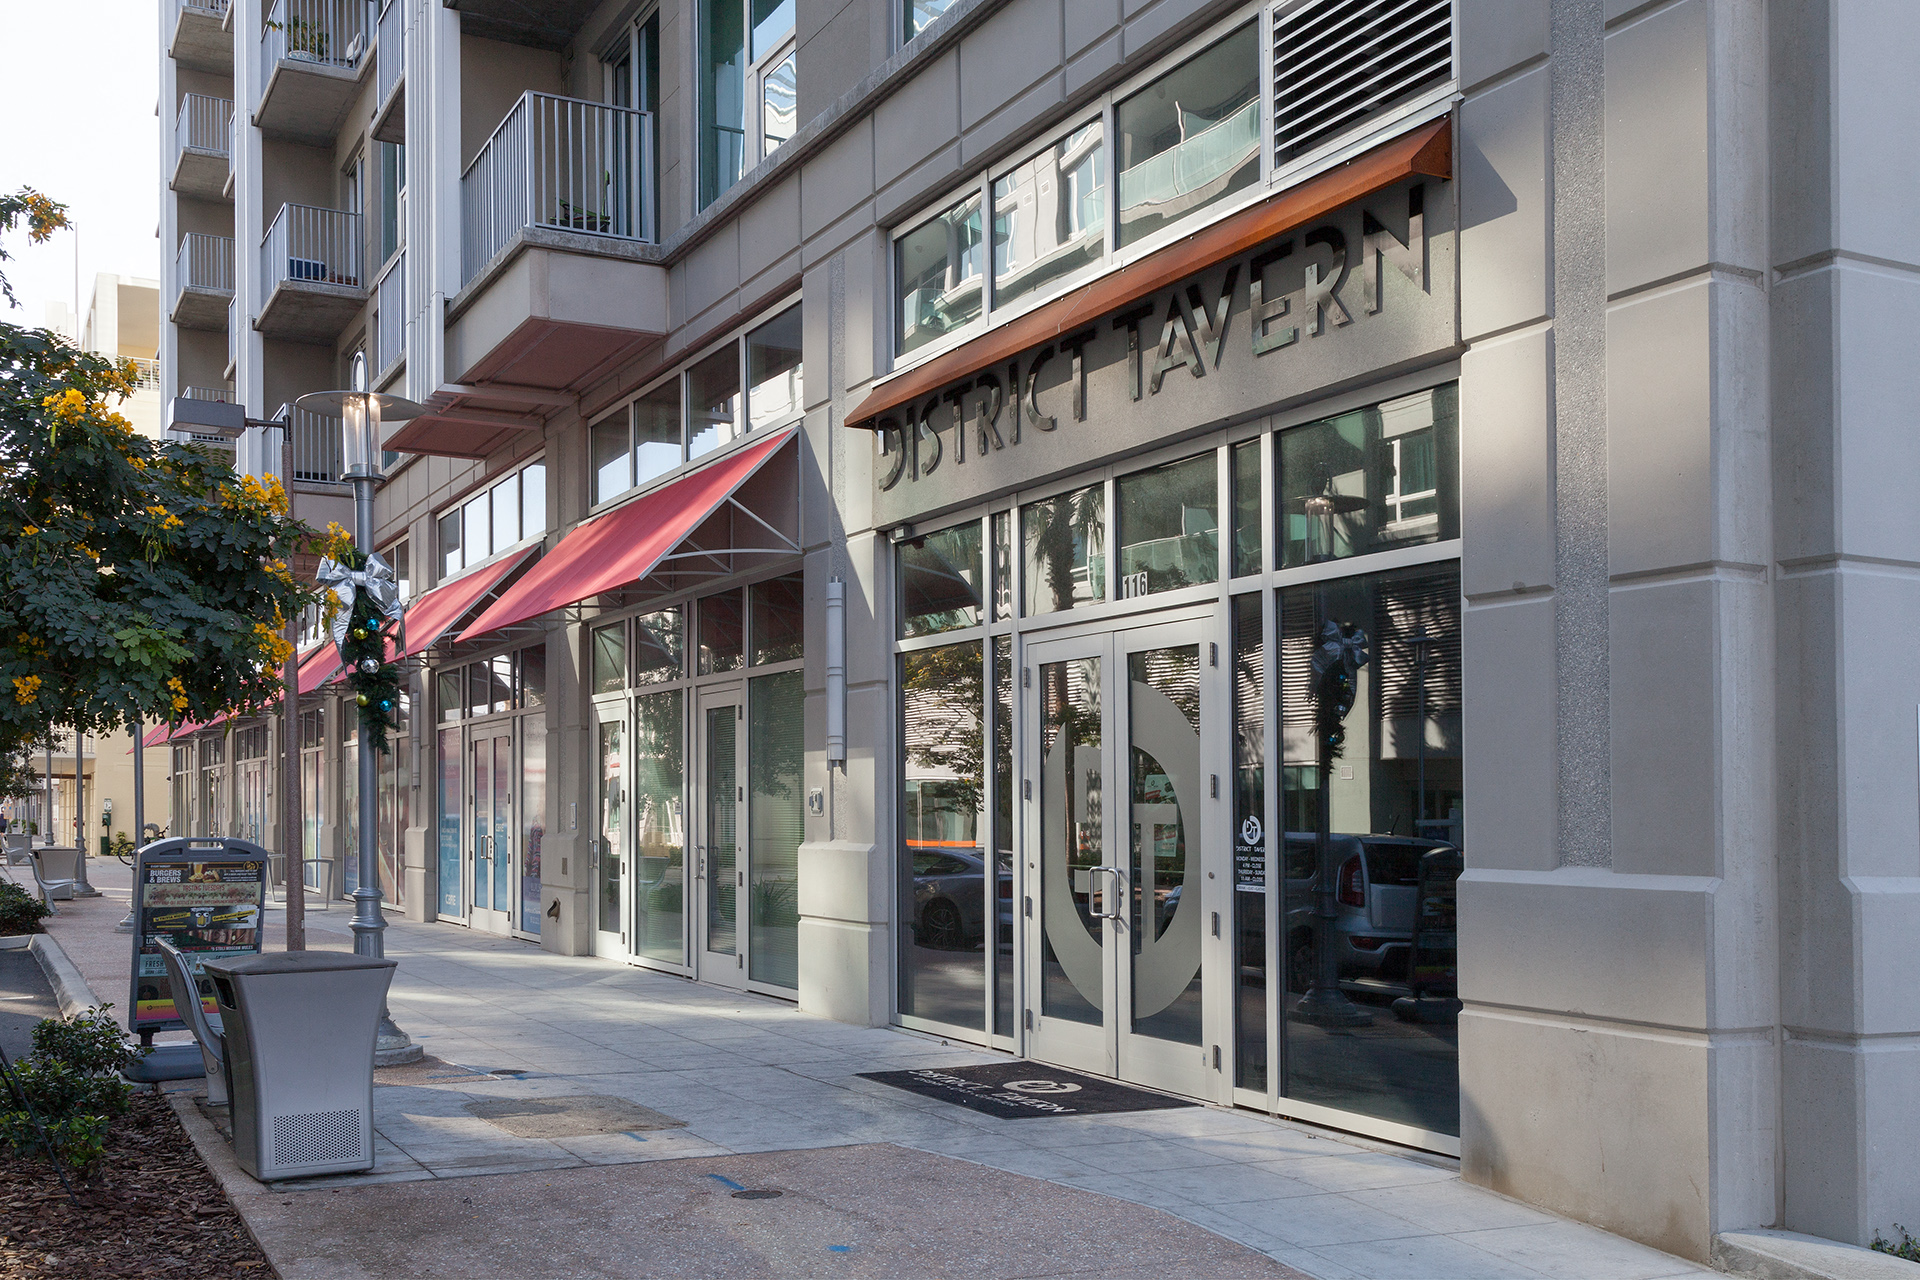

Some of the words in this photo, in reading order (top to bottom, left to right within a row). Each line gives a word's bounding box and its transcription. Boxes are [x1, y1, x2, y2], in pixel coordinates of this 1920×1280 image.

[877, 329, 1096, 491] DISTRICT
[1113, 184, 1426, 401] TAVERN
[1124, 573, 1146, 599] 116
[150, 869, 182, 877] BURGERS
[203, 884, 225, 892] TUESDAYS
[145, 960, 165, 968] FRESH
